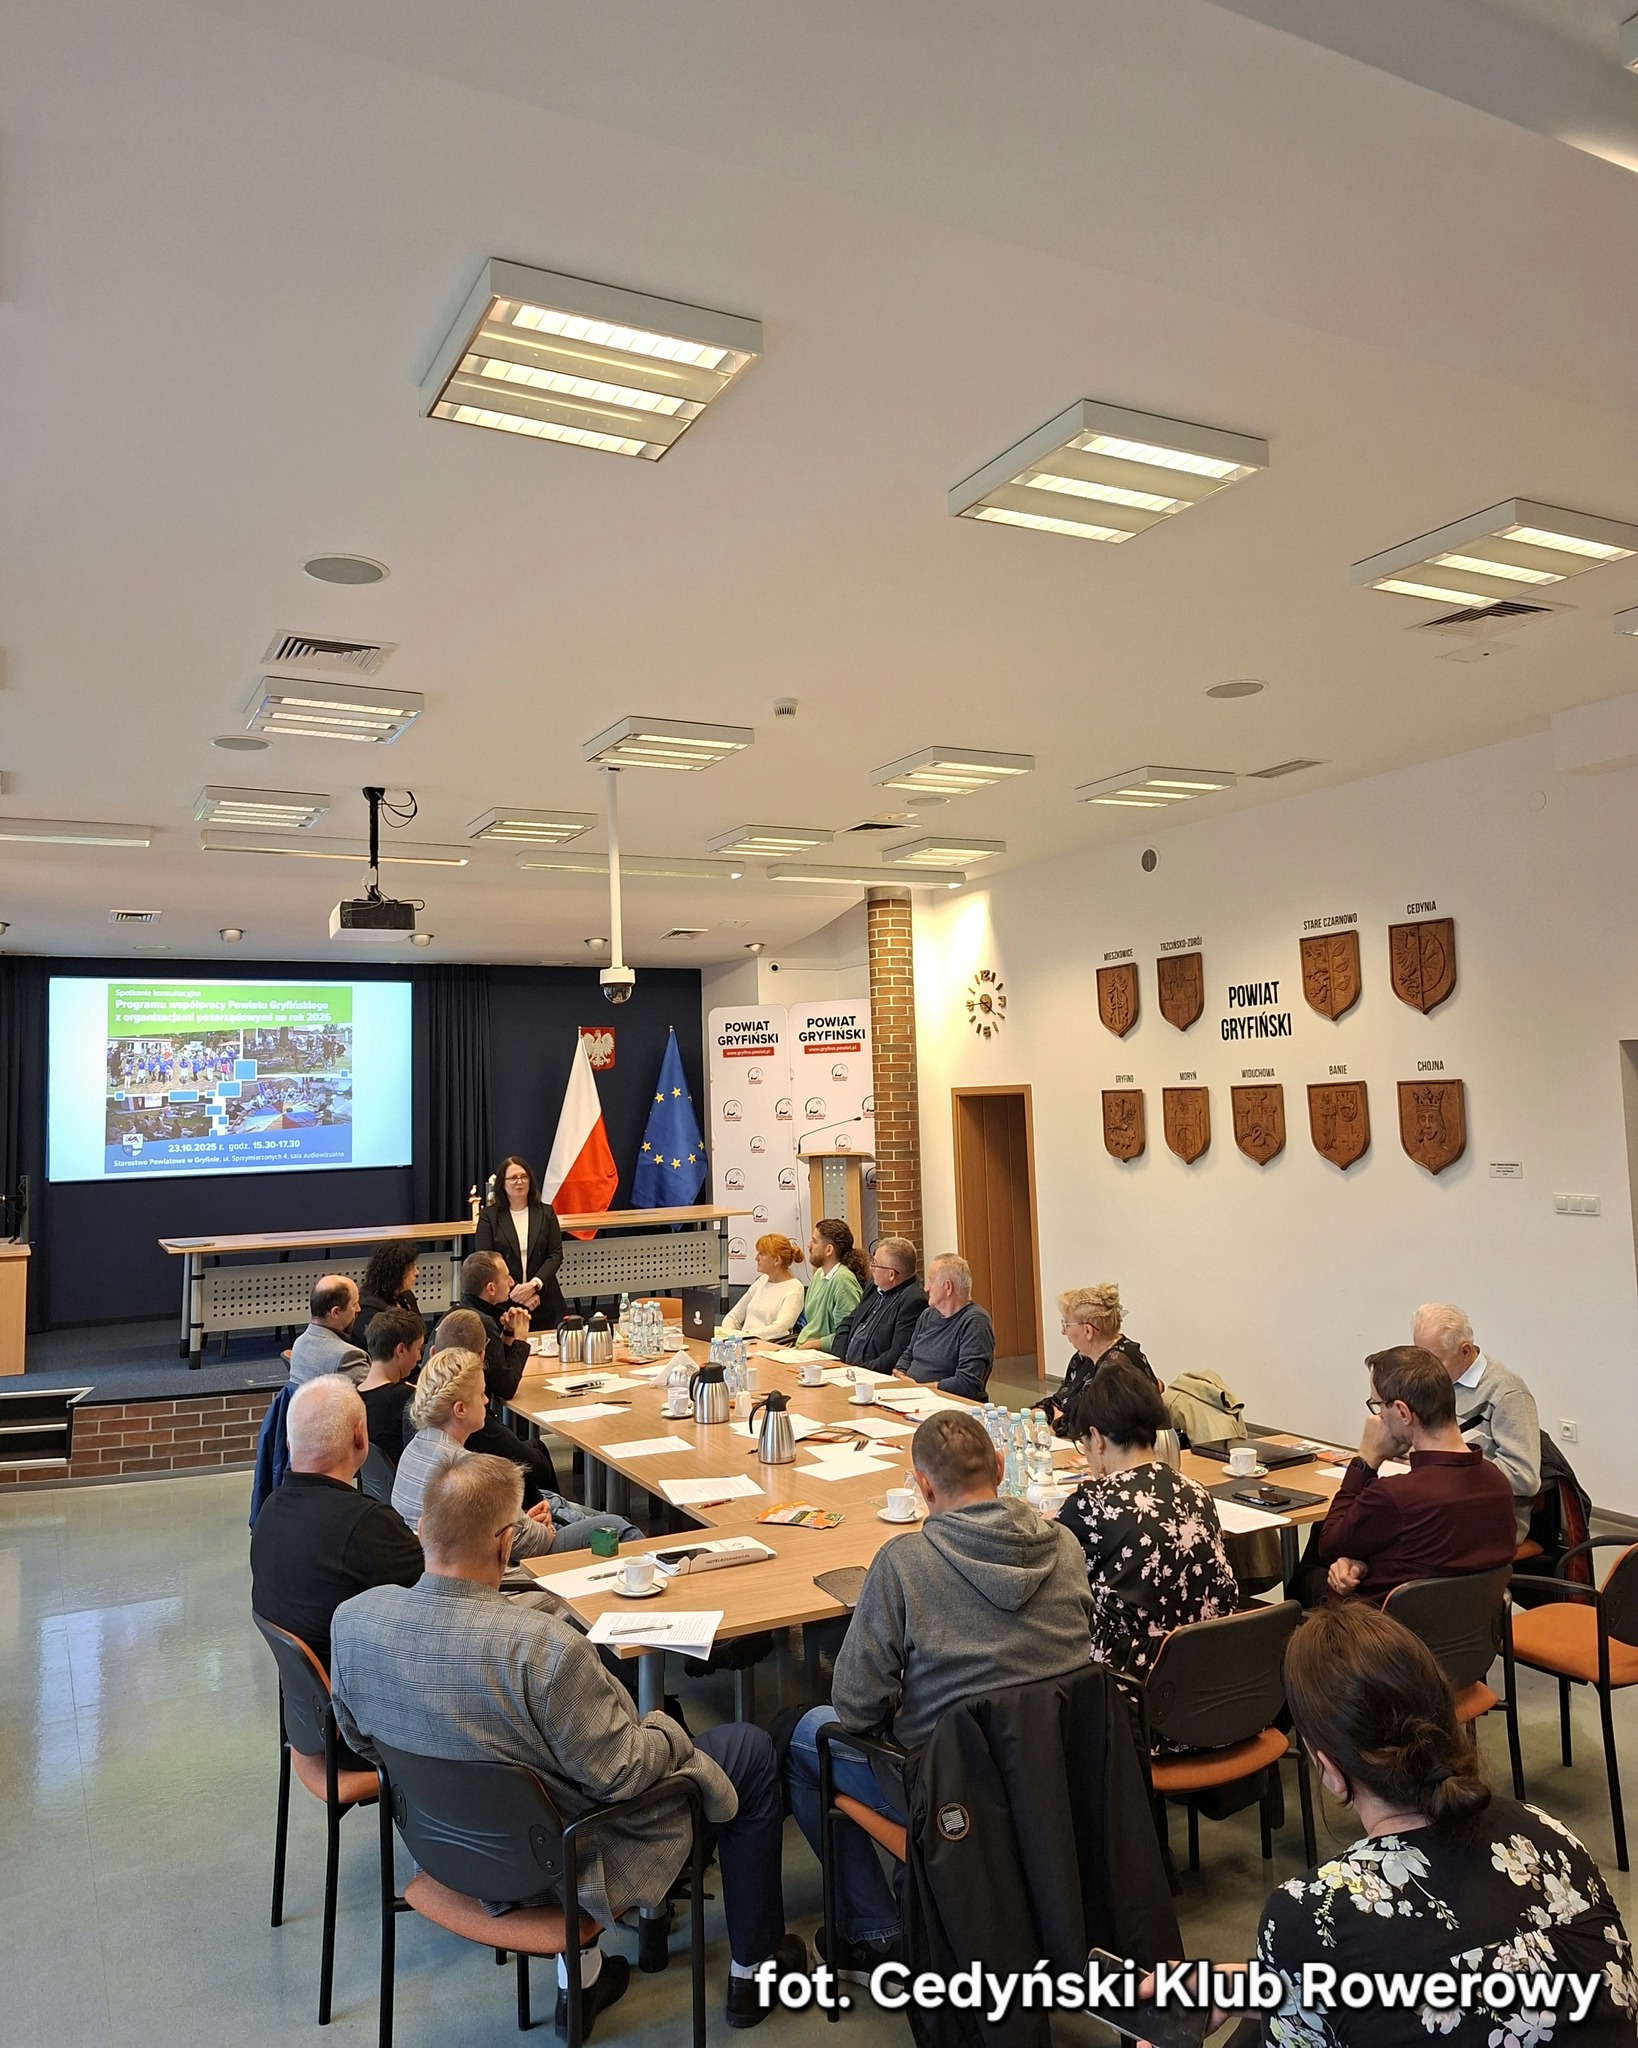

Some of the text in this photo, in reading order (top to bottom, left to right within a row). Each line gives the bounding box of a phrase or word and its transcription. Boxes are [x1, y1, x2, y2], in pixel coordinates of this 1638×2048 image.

[1406, 900, 1437, 915] CEDYNIA
[1303, 912, 1358, 931] STARE CZARNOWO
[1160, 935, 1203, 952] TRZCIŃSKO-ZDRÓJ
[1103, 948, 1133, 961] MIESZKOWICE
[115, 988, 201, 998] Spotkanie konsultacyjne
[1228, 981, 1280, 1009] POWIAT
[115, 999, 329, 1011] Programu współpracy Powiatu Gryfińskiego
[115, 1012, 332, 1024] z organizacjami pozarządowymi na rok 2026
[807, 1016, 857, 1029] POWIAT
[725, 1020, 770, 1033] POWIAT
[1221, 1011, 1293, 1041] GRYFIŃSKI
[717, 1032, 779, 1046] GRYFIŃSKI
[798, 1027, 866, 1042] GRYFIŃSKI
[1328, 1064, 1347, 1075] BANIE
[1417, 1060, 1444, 1072] CHOJNA
[1115, 1074, 1134, 1083] GRYFINO
[1179, 1070, 1197, 1081] MORYŃ
[1241, 1068, 1275, 1079] WIDUCHOWA
[168, 1142, 217, 1152] 23.10.2025
[228, 1142, 251, 1152] godz.
[252, 1139, 301, 1150] 15.30-17.30
[113, 1159, 148, 1167] Starostwo
[149, 1158, 186, 1166] Powiatowe
[194, 1155, 222, 1165] Gryfinie,
[232, 1153, 282, 1163] Sprzymierzonych
[303, 1151, 345, 1159] audiowizualna
